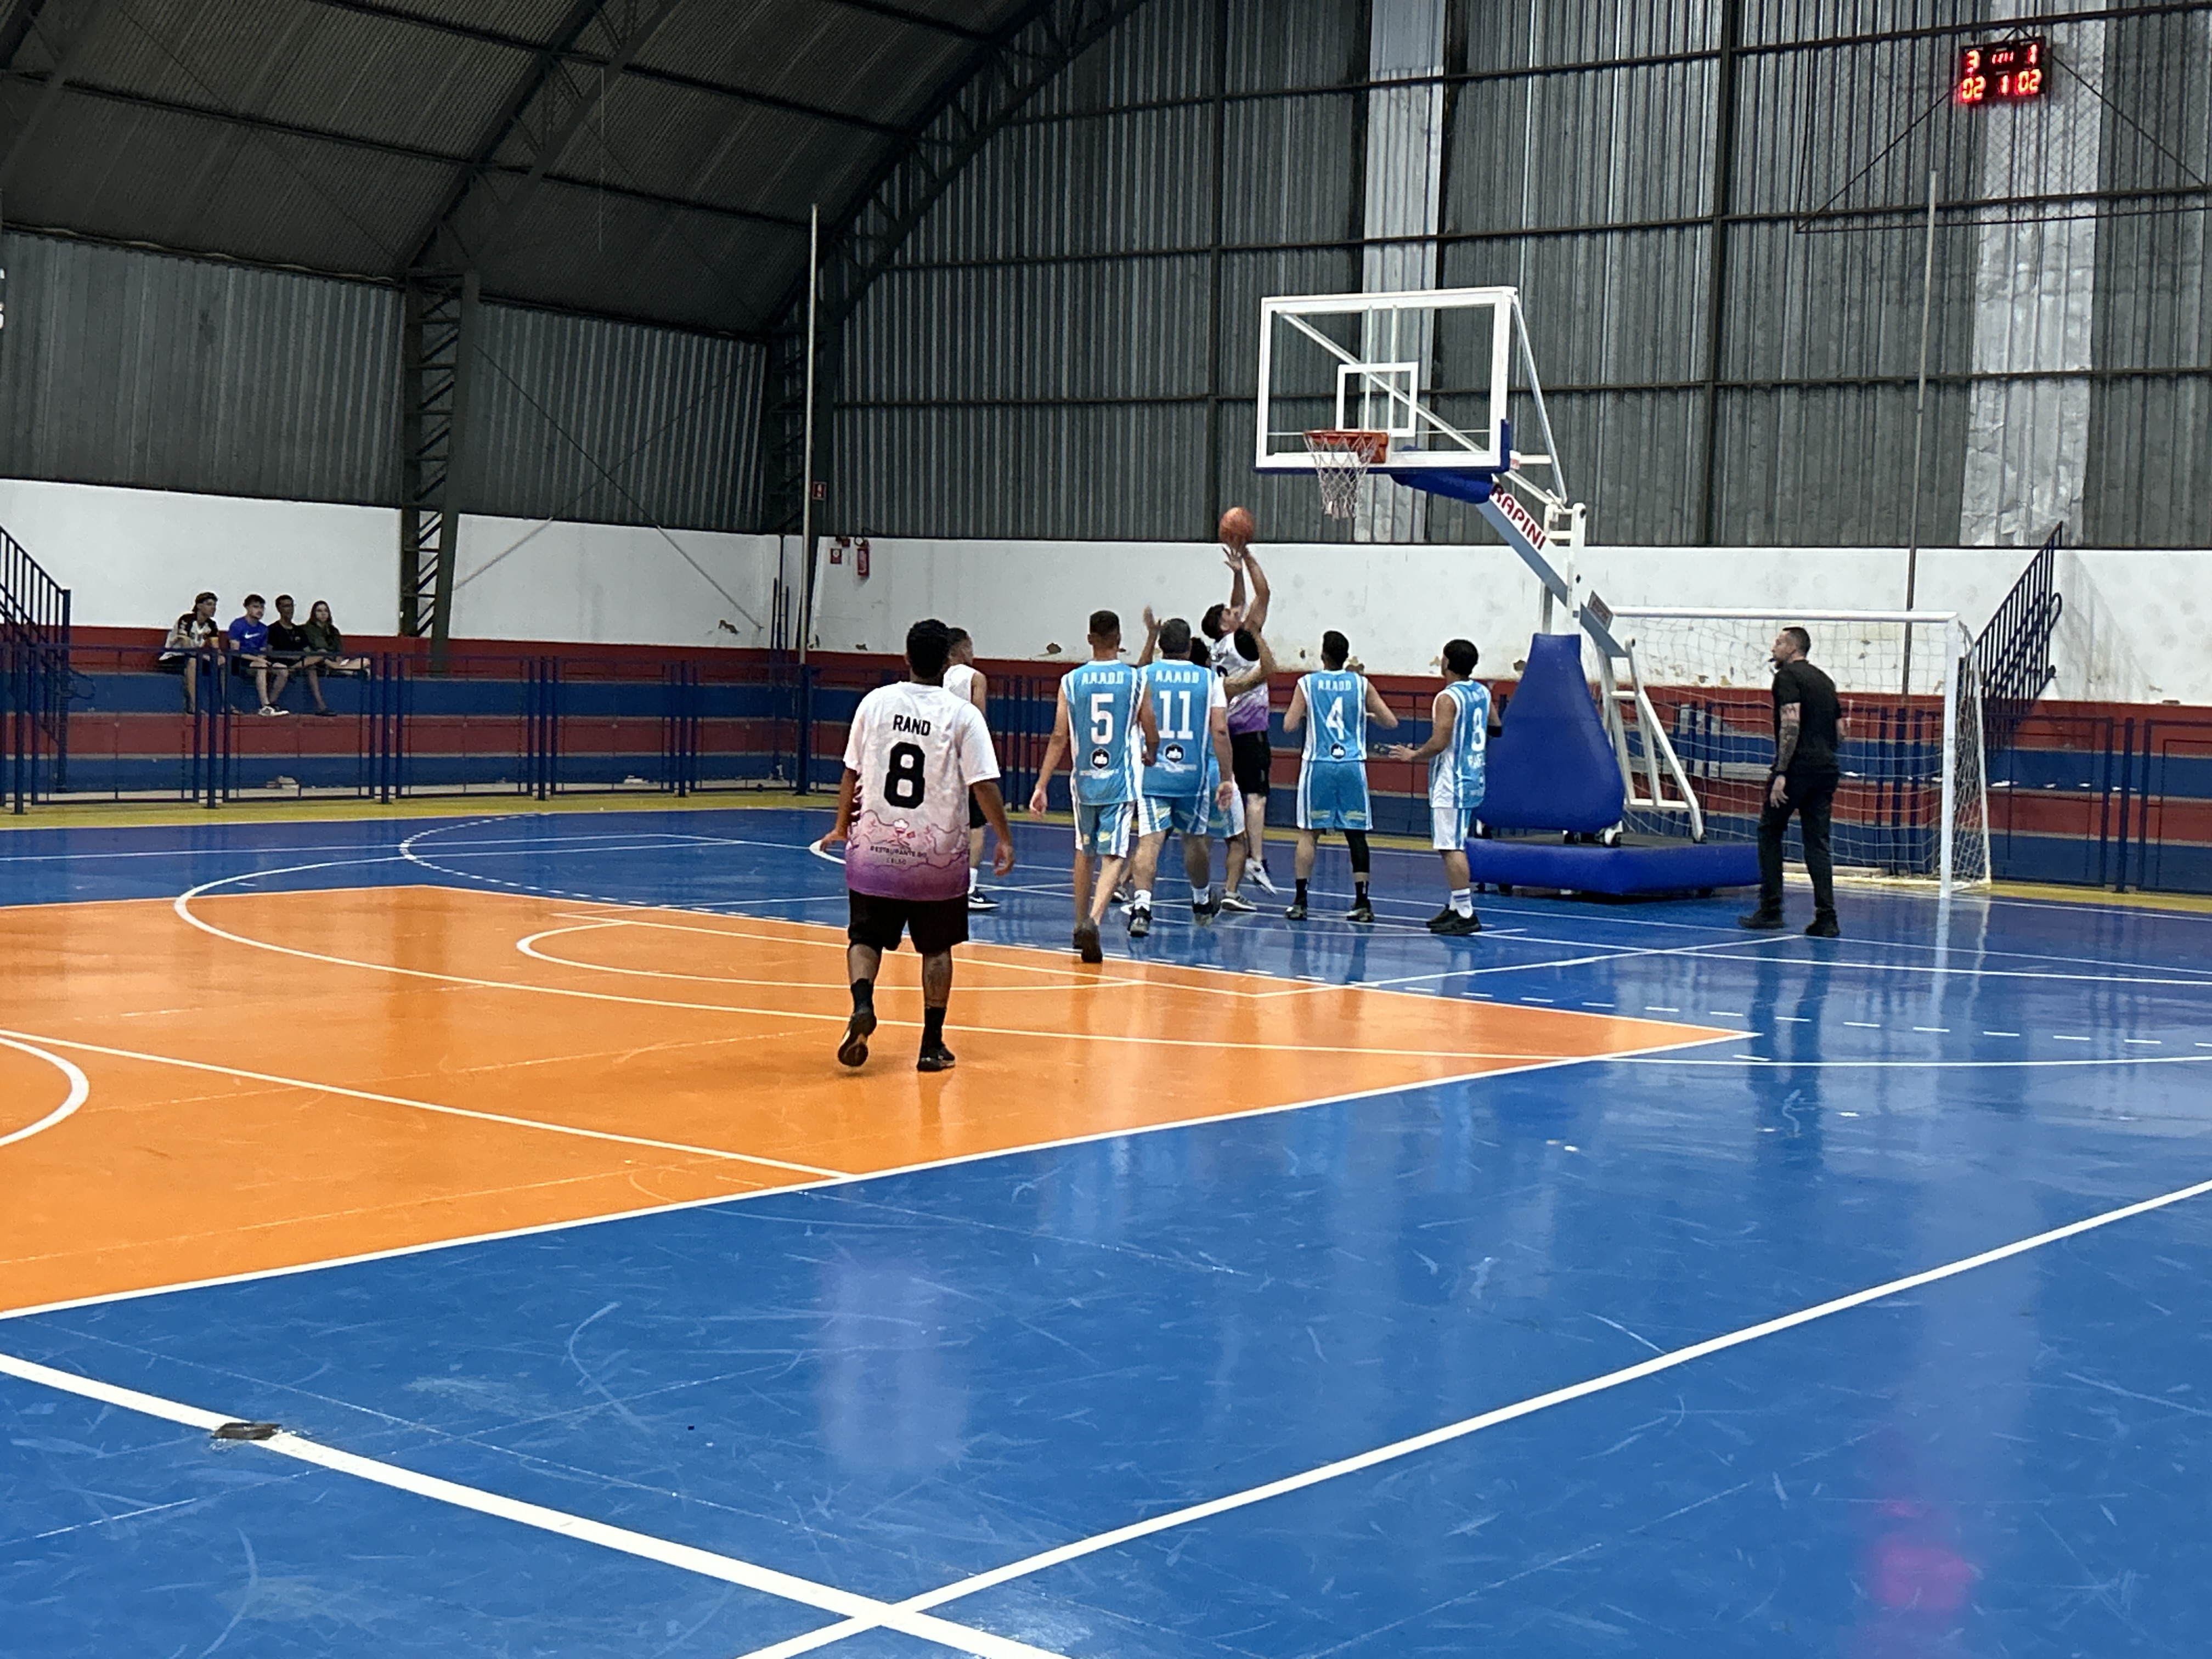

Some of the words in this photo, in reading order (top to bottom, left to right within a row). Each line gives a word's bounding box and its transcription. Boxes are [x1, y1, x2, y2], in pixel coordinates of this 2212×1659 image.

[2017, 69, 2042, 94] 02
[893, 714, 931, 736] RAND
[1091, 693, 1114, 744] 5
[1158, 690, 1193, 740] 11
[1325, 696, 1344, 740] 4
[1471, 707, 1486, 752] 8
[884, 741, 926, 809] 8
